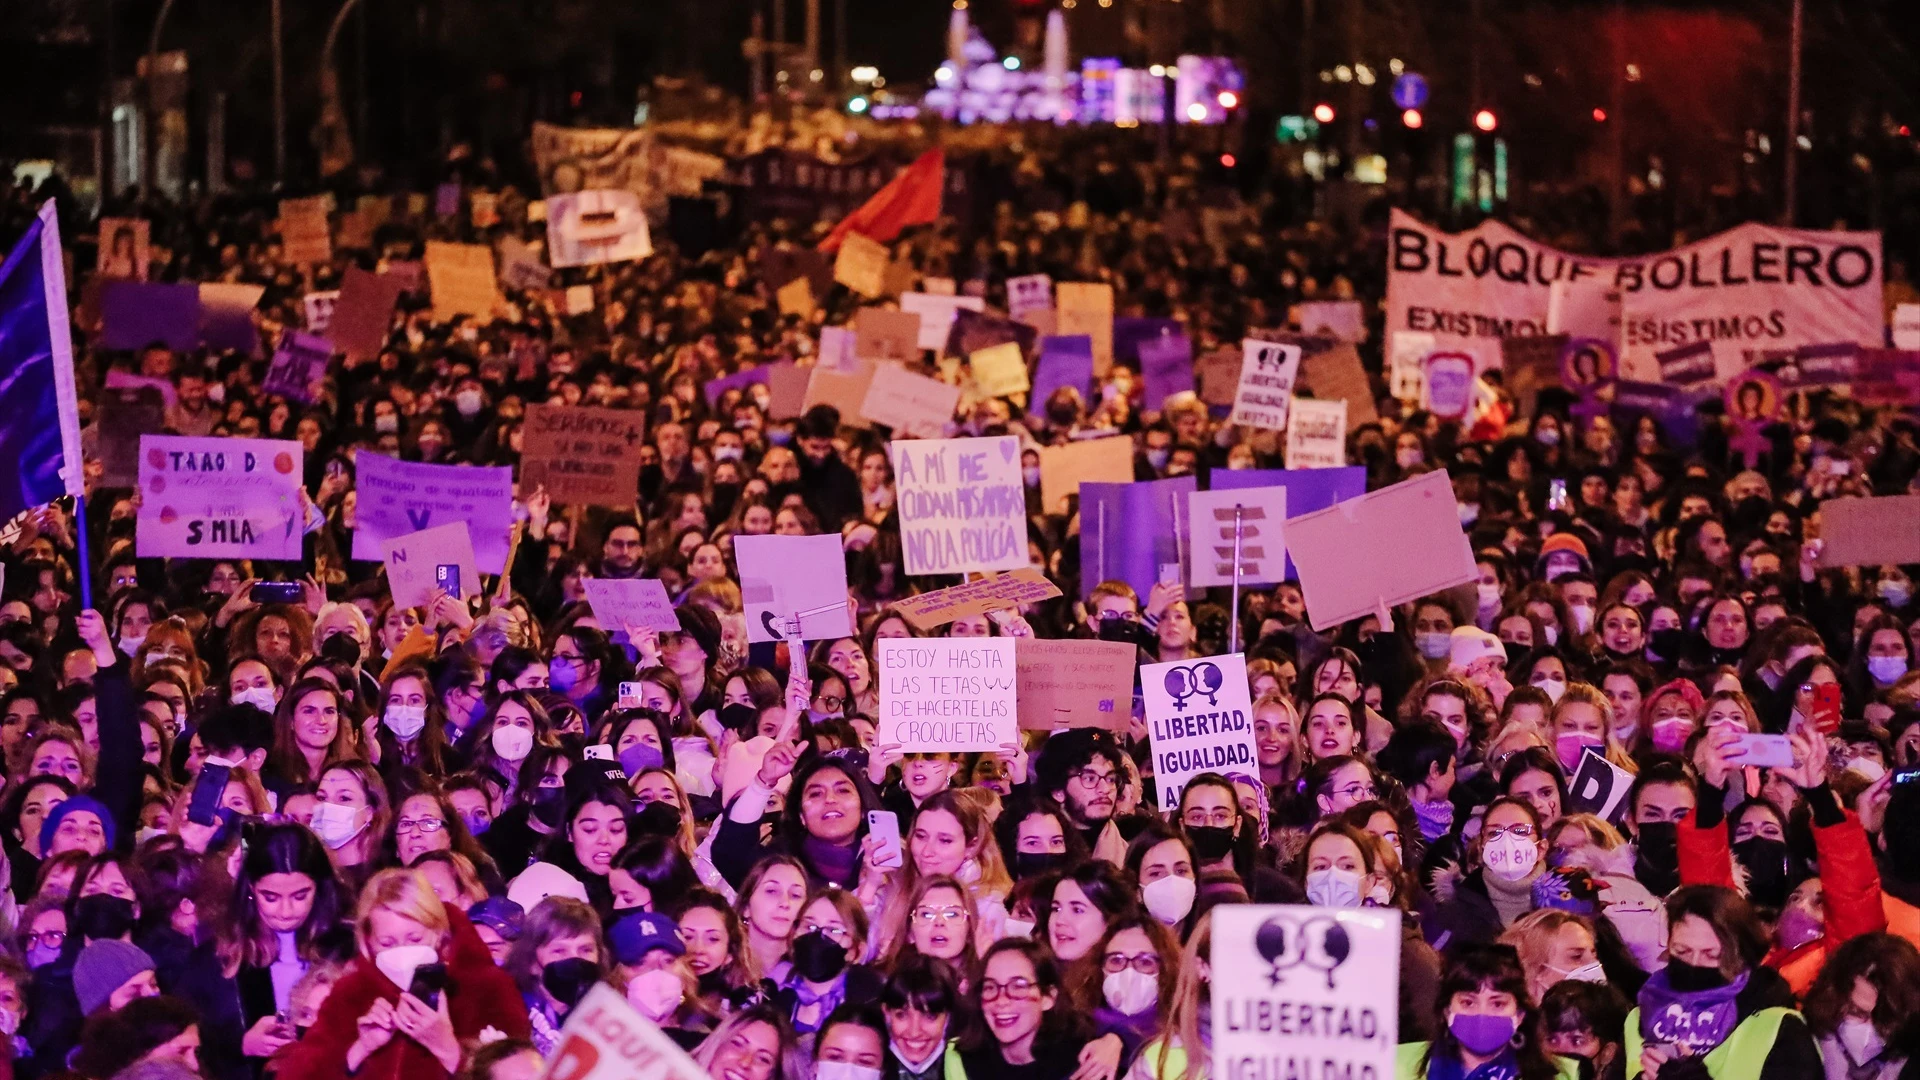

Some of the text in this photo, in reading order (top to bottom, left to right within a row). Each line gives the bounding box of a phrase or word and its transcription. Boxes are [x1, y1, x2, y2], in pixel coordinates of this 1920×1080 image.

[1394, 228, 1874, 292] BLOQUE BOLLERO
[1626, 309, 1786, 347] ESISTIMOS
[900, 447, 917, 487] A
[958, 451, 989, 484] ME
[960, 521, 1020, 564] POLICÍA
[886, 648, 1003, 669] ESTOY HASTA
[891, 676, 981, 695] LAS TETAS
[891, 700, 912, 717] DE
[1098, 699, 1115, 713] 8M
[896, 721, 997, 744] CROQUETAS
[1154, 709, 1251, 742] LIBERTAD,
[1159, 742, 1256, 775] IGUALDAD,
[1489, 849, 1534, 866] 8M 8M
[1226, 998, 1388, 1050] LIBERTAD,
